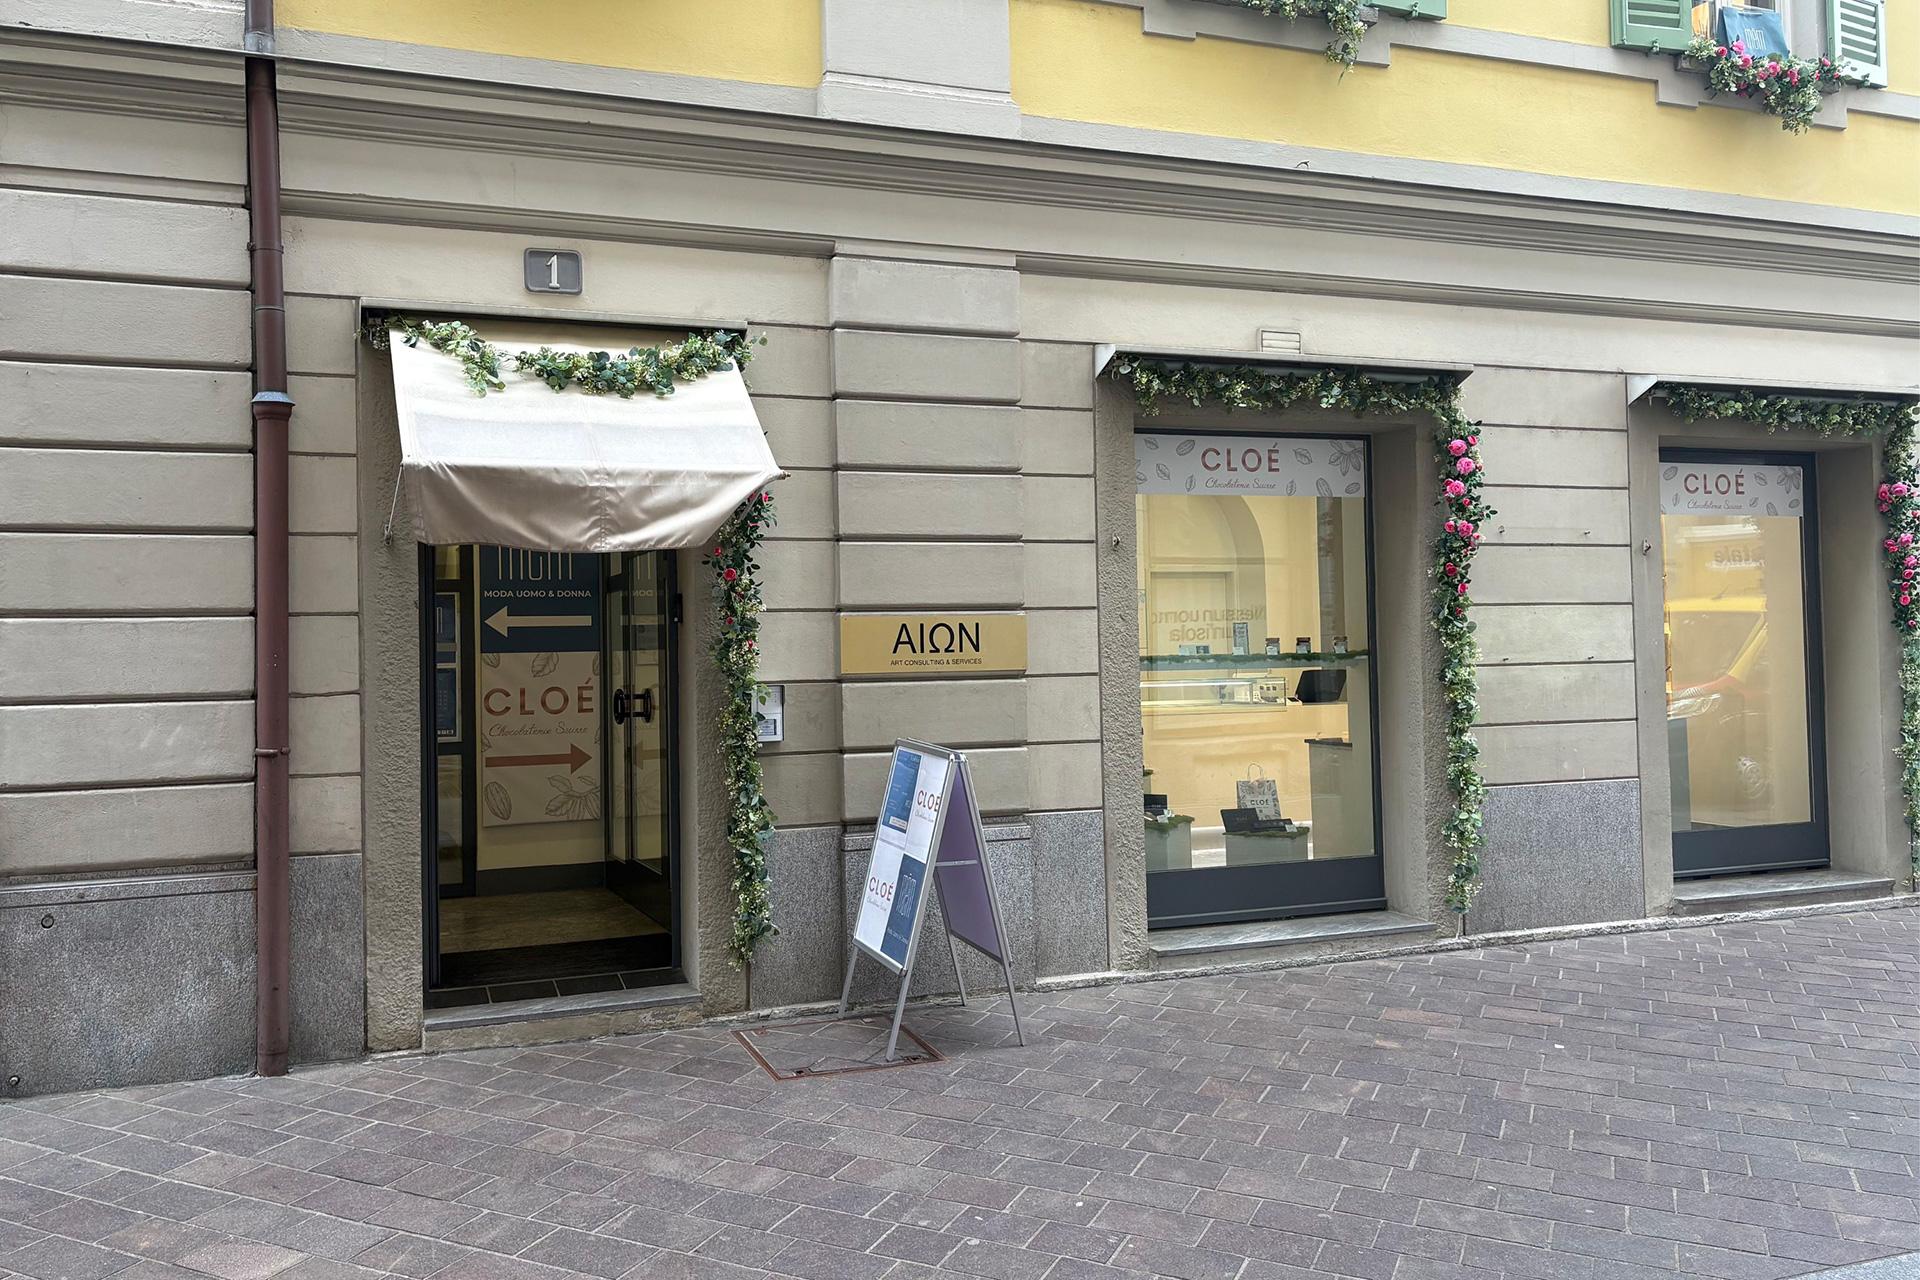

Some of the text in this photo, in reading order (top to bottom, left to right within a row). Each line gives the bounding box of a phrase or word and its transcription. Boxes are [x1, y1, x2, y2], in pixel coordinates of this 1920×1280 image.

[546, 254, 560, 288] 1
[1201, 442, 1280, 473] CLOÉ
[1684, 468, 1745, 495] CLOÉ
[484, 590, 592, 598] MODA UOMO & DONNA
[890, 657, 982, 667] ART CONSULTING & SERVICES
[484, 677, 594, 716] CLOÉ
[1250, 798, 1270, 806] CLOÉ
[869, 876, 895, 902] CLOÉ
